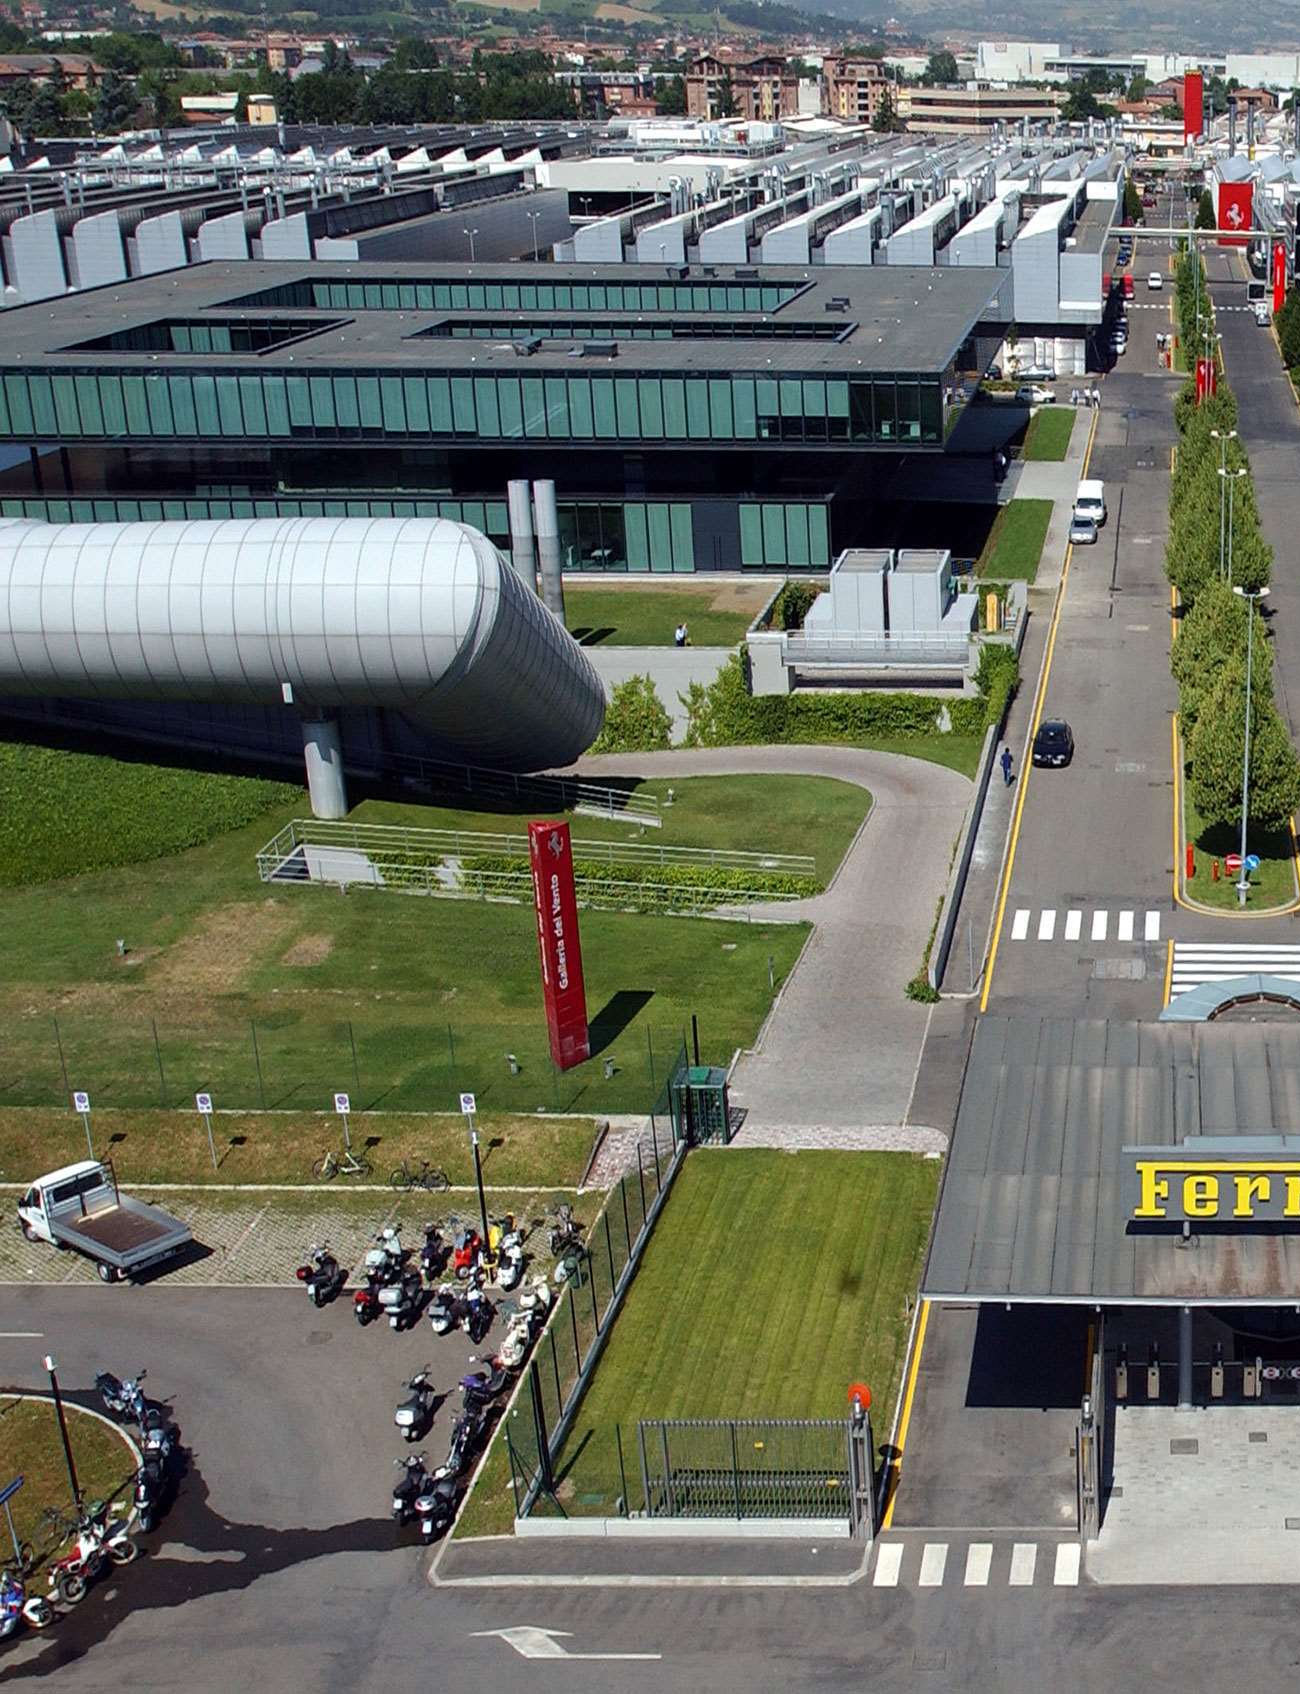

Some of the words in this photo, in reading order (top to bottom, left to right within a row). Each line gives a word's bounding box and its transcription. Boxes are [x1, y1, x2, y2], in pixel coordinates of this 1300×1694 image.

[551, 874, 562, 915] Vento
[553, 916, 563, 937] del
[557, 939, 569, 989] Galleria
